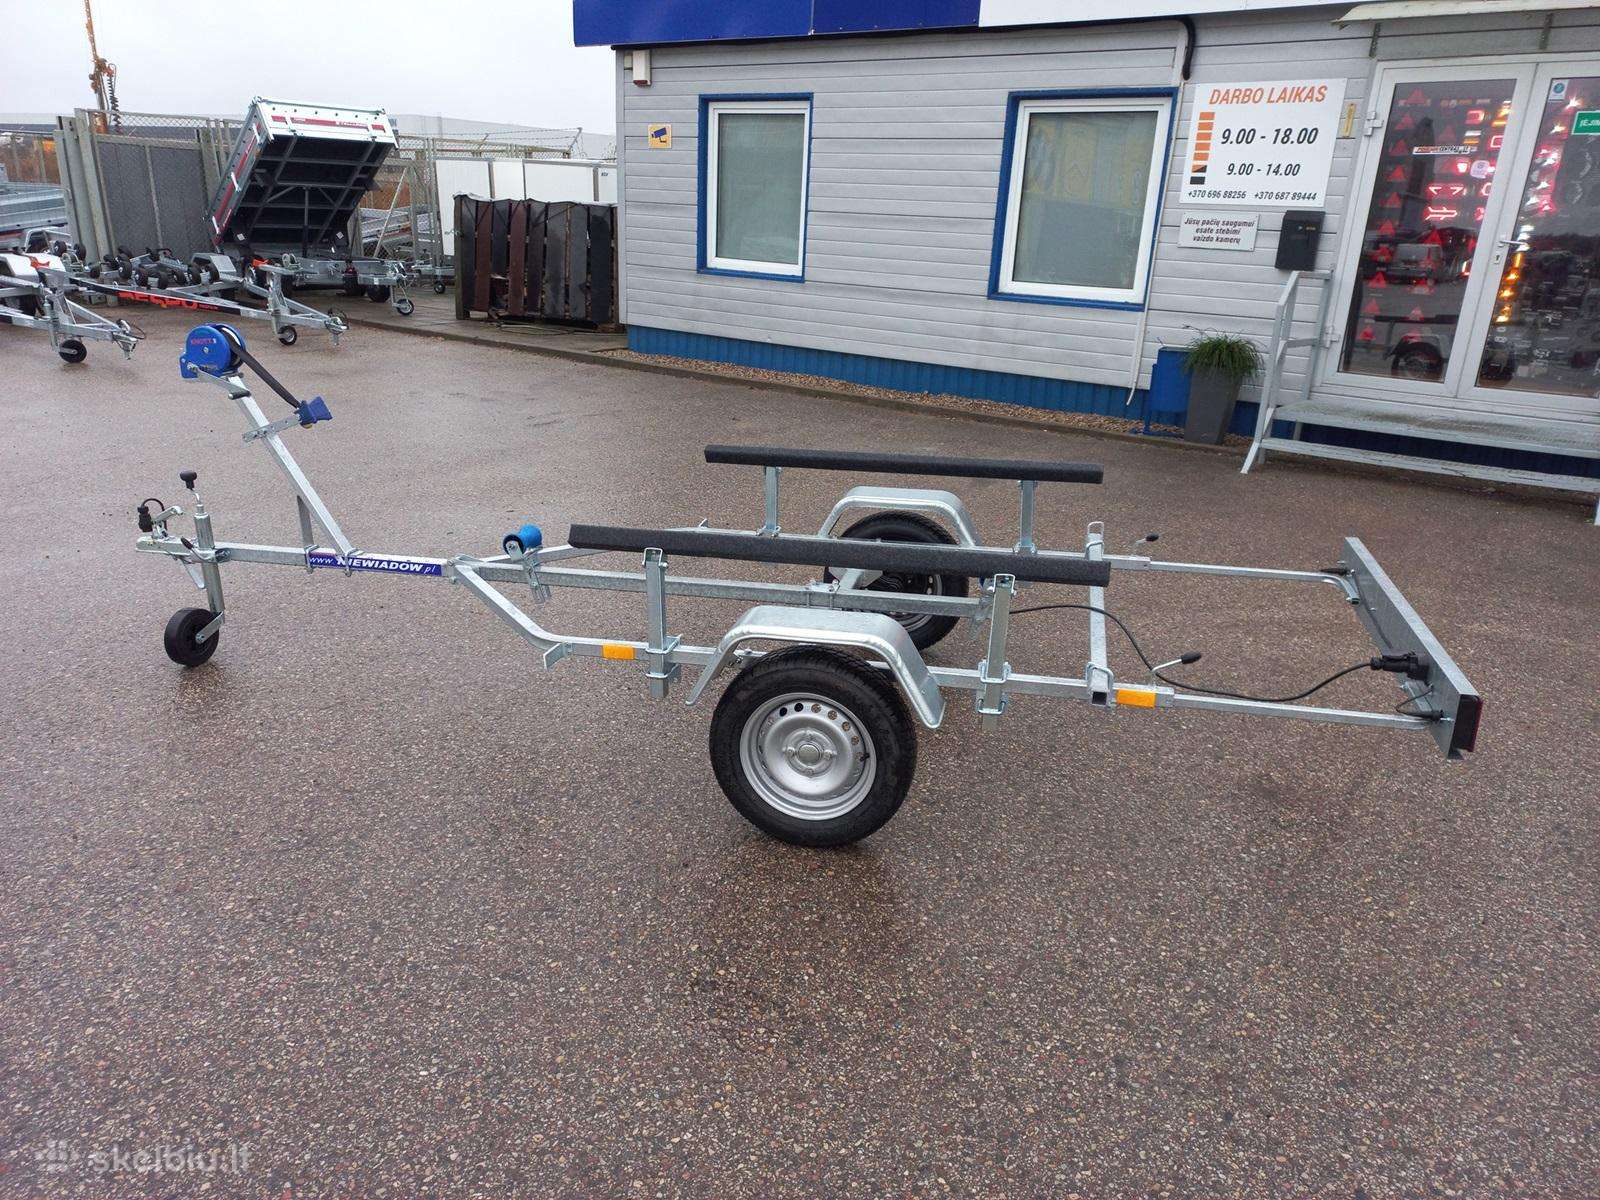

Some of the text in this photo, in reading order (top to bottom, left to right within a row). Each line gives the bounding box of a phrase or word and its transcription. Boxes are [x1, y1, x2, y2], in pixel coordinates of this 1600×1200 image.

[1209, 85, 1328, 105] DARBO LAIKAS
[1221, 128, 1256, 144] 9.00
[1272, 127, 1318, 144] 18.00
[1226, 163, 1254, 176] 9.00
[1265, 163, 1301, 176] 14.00
[1188, 190, 1317, 201] +370 696 88256 +370 687 89444
